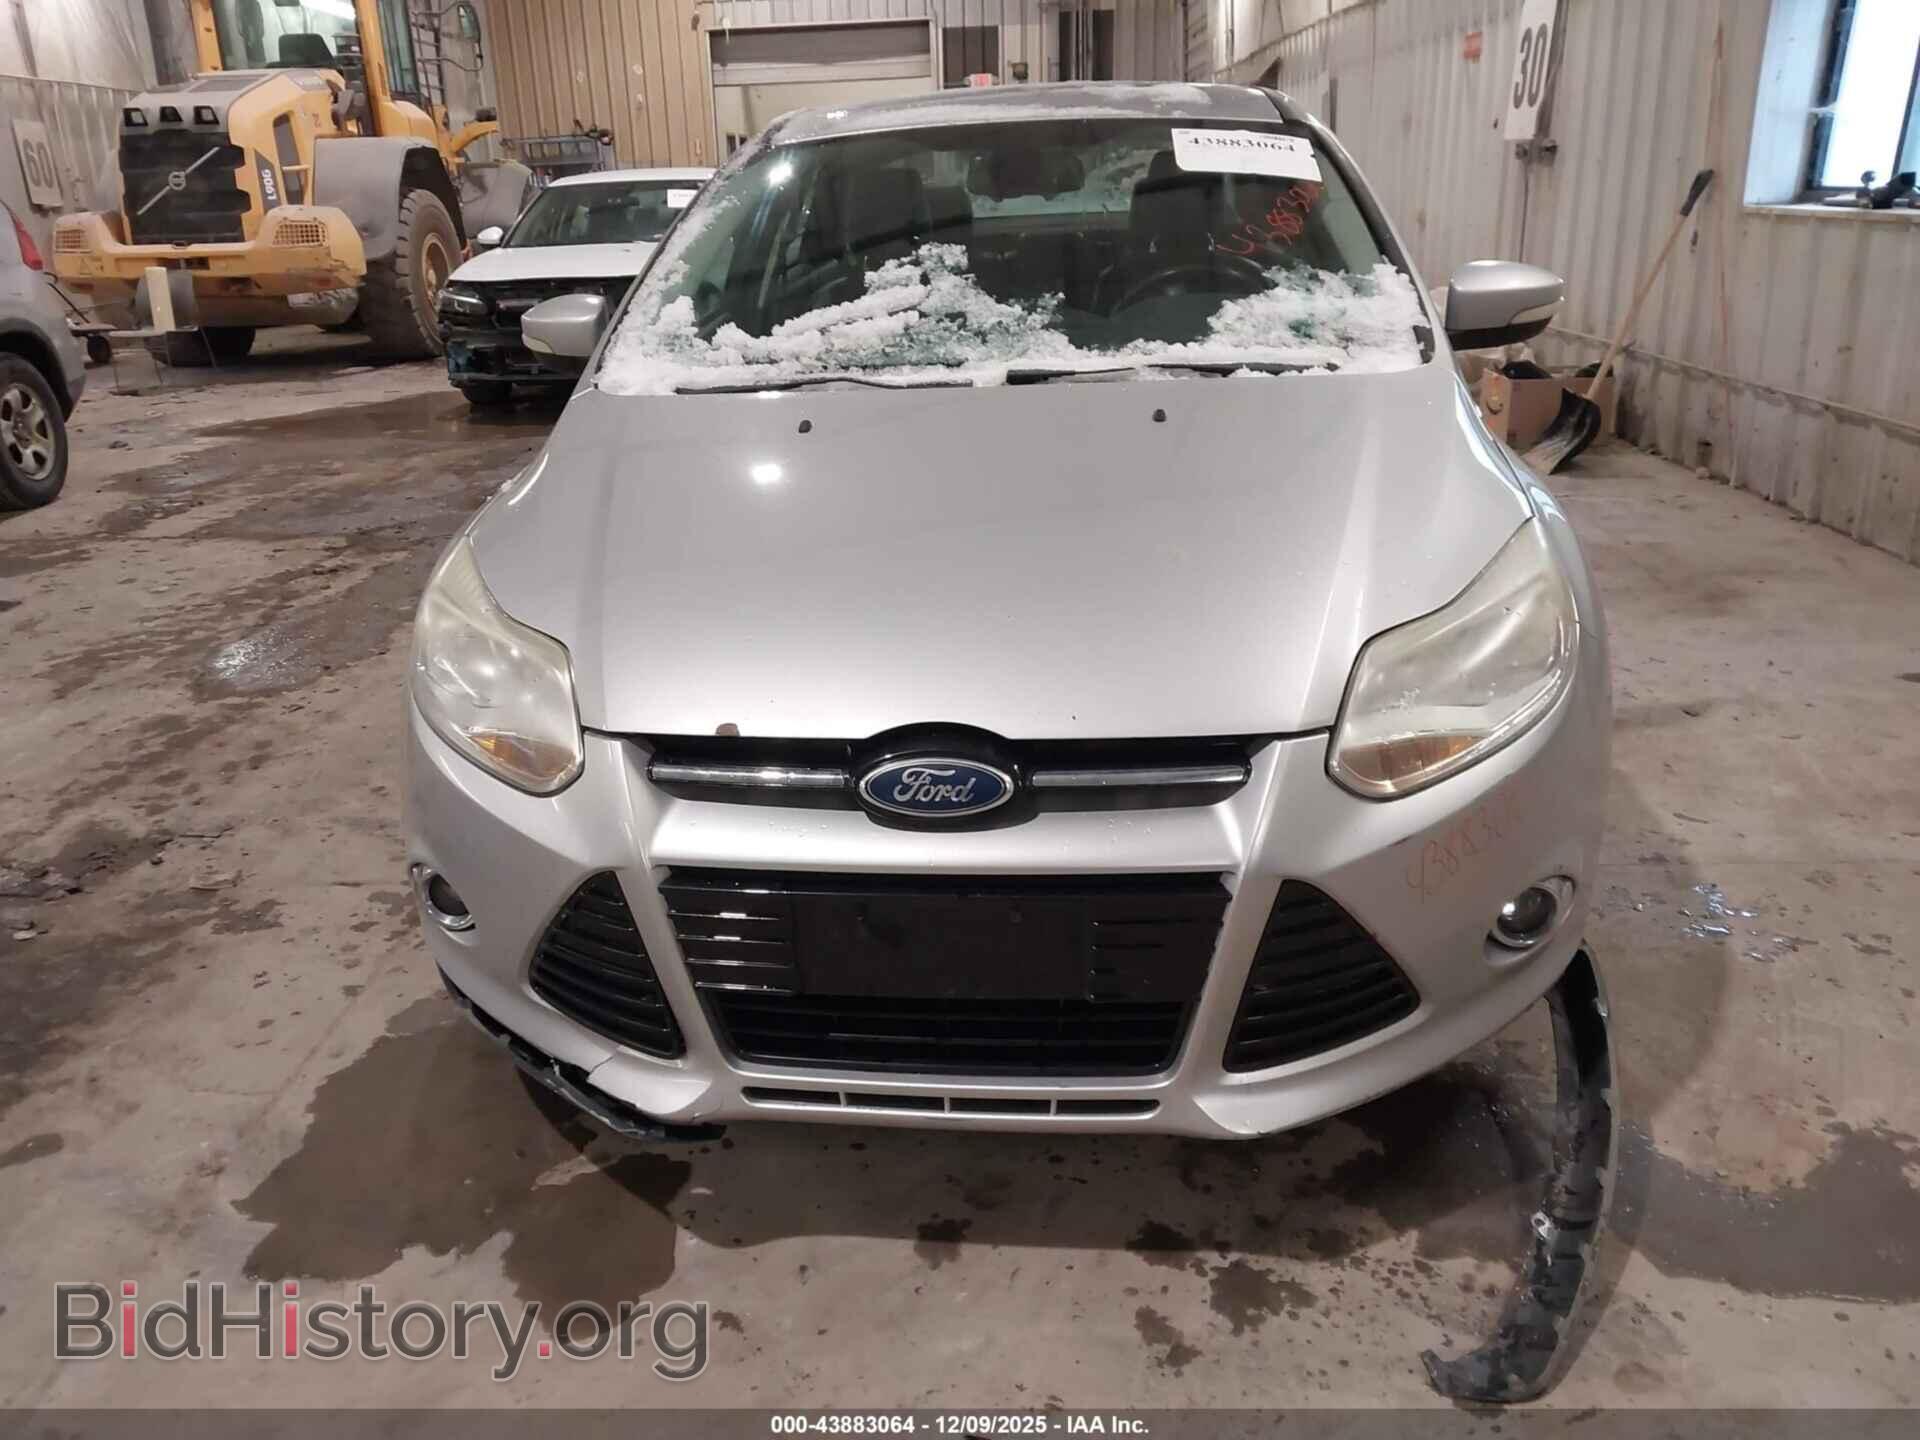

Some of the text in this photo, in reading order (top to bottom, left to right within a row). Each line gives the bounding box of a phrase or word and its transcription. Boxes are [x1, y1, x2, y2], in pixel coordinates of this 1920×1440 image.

[1513, 23, 1548, 109] 30
[1187, 136, 1296, 152] 43883064
[22, 138, 54, 189] 60
[261, 168, 277, 201] L90G
[893, 767, 976, 803] Ford
